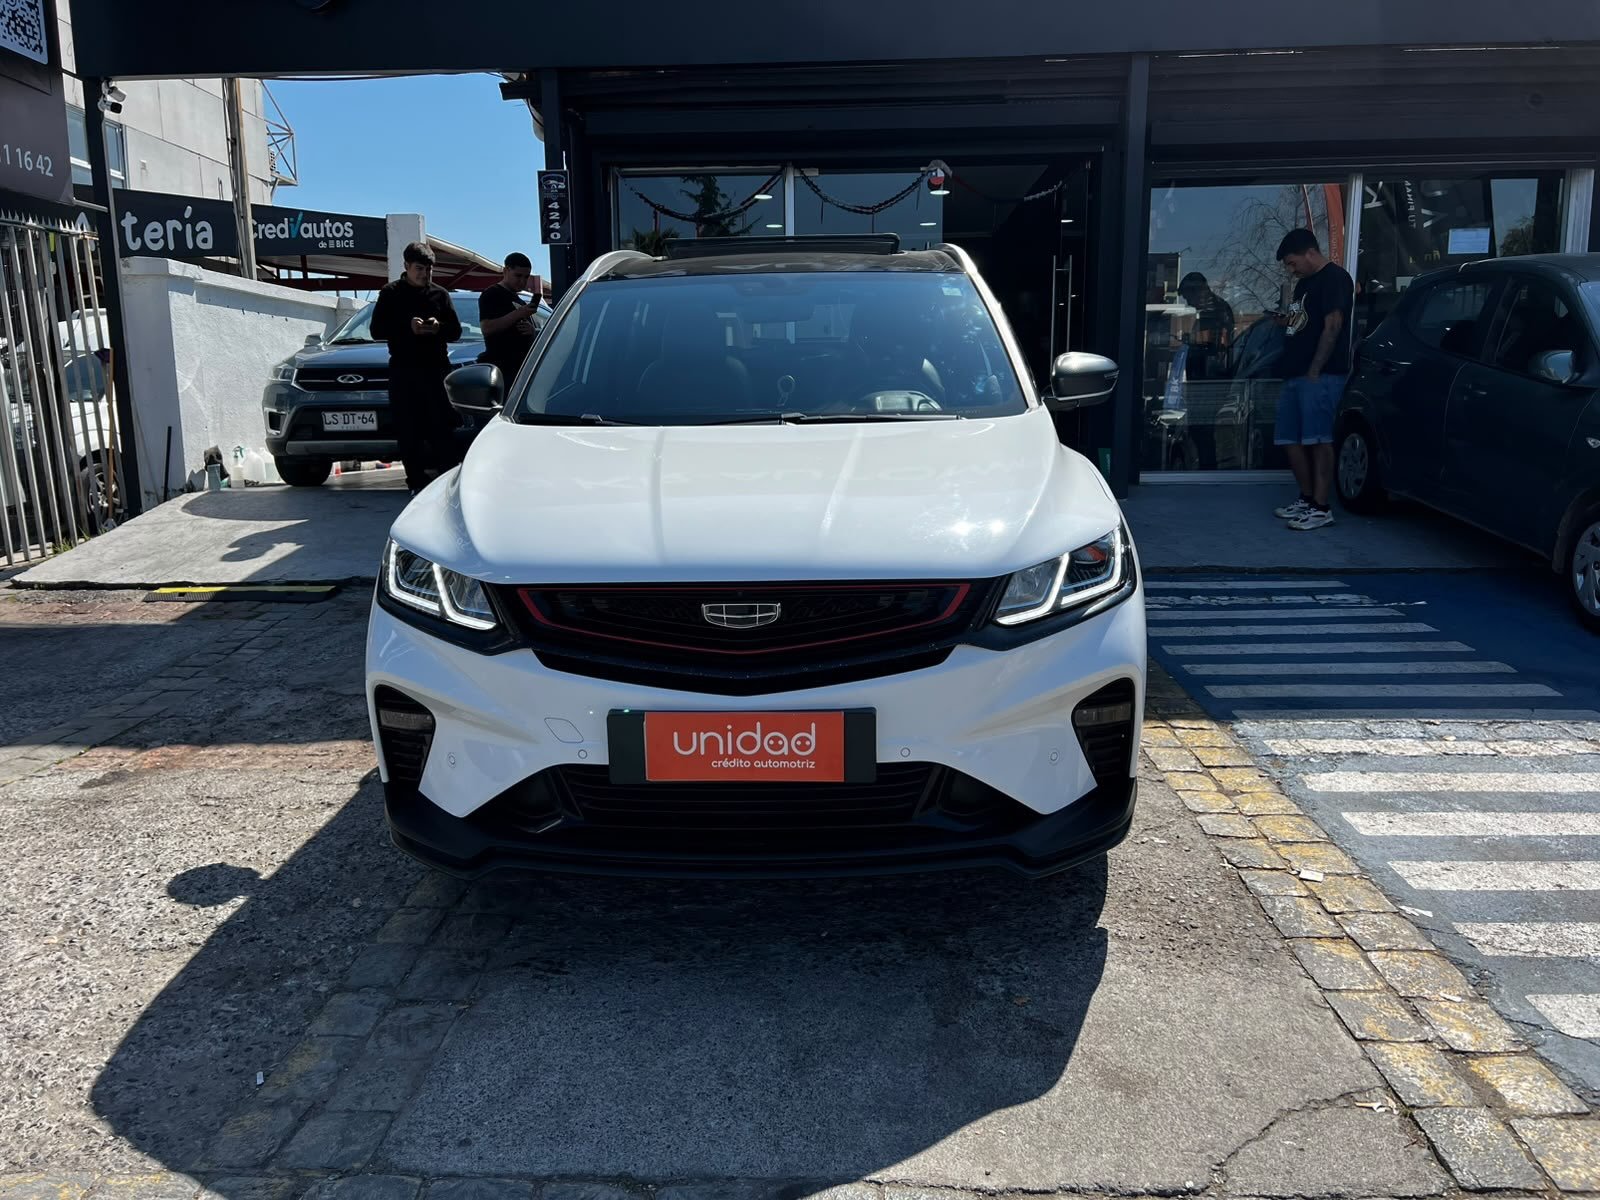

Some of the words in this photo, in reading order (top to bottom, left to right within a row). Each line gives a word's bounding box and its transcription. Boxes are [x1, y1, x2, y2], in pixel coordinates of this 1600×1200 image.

[36, 154, 54, 177] 42
[547, 201, 561, 240] 4240
[318, 240, 328, 249] de
[335, 239, 355, 248] BICE
[673, 721, 816, 756] unidad
[711, 758, 751, 769] crédito
[753, 759, 816, 769] automotriz
